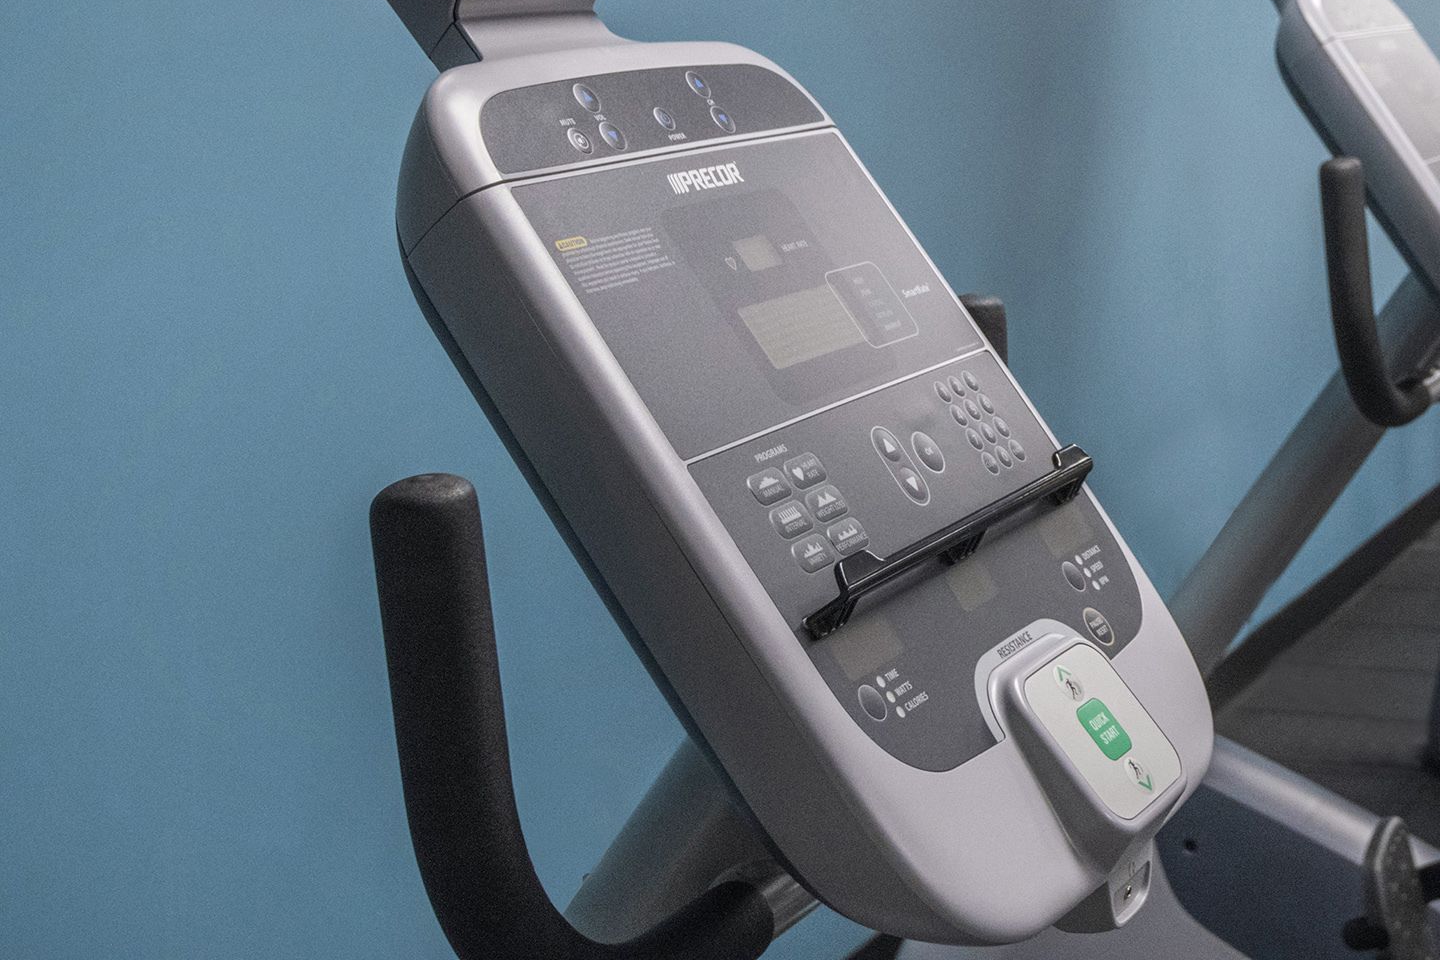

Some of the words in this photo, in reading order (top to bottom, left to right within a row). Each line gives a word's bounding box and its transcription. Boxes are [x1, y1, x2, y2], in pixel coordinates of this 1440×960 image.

[559, 117, 576, 126] MUTE
[668, 162, 744, 195] PRECOR
[754, 443, 788, 463] PROGRAMS
[816, 503, 836, 519] WEIGHT
[836, 531, 869, 552] PERFORMANCE
[996, 630, 1033, 659] RESISTANCE
[884, 667, 899, 682] TIME
[894, 680, 913, 697] WATTS
[904, 691, 929, 712] CALORIES
[1088, 711, 1110, 731] QUICK
[1099, 724, 1120, 745] START
